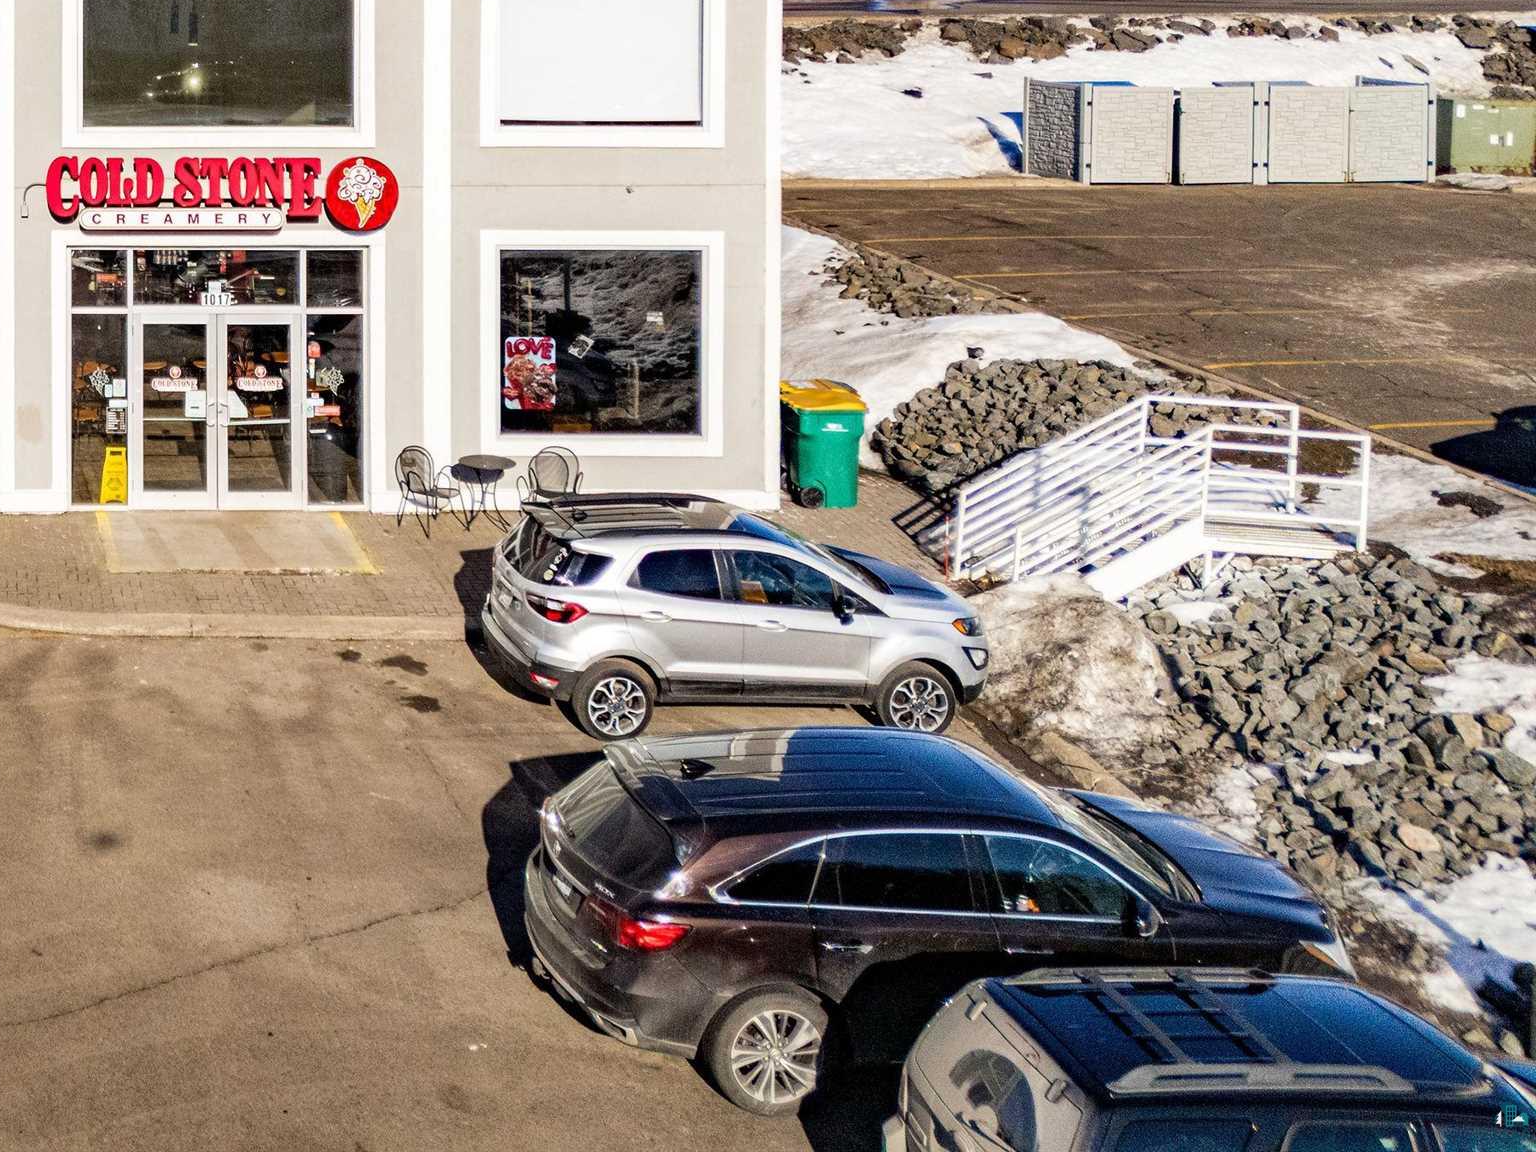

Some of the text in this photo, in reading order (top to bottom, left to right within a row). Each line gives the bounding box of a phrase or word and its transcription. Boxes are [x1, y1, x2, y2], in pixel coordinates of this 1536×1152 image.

[45, 156, 323, 218] COLD STONE
[91, 213, 272, 225] CREAMERY
[204, 294, 230, 305] 1017
[506, 338, 555, 360] LOVE
